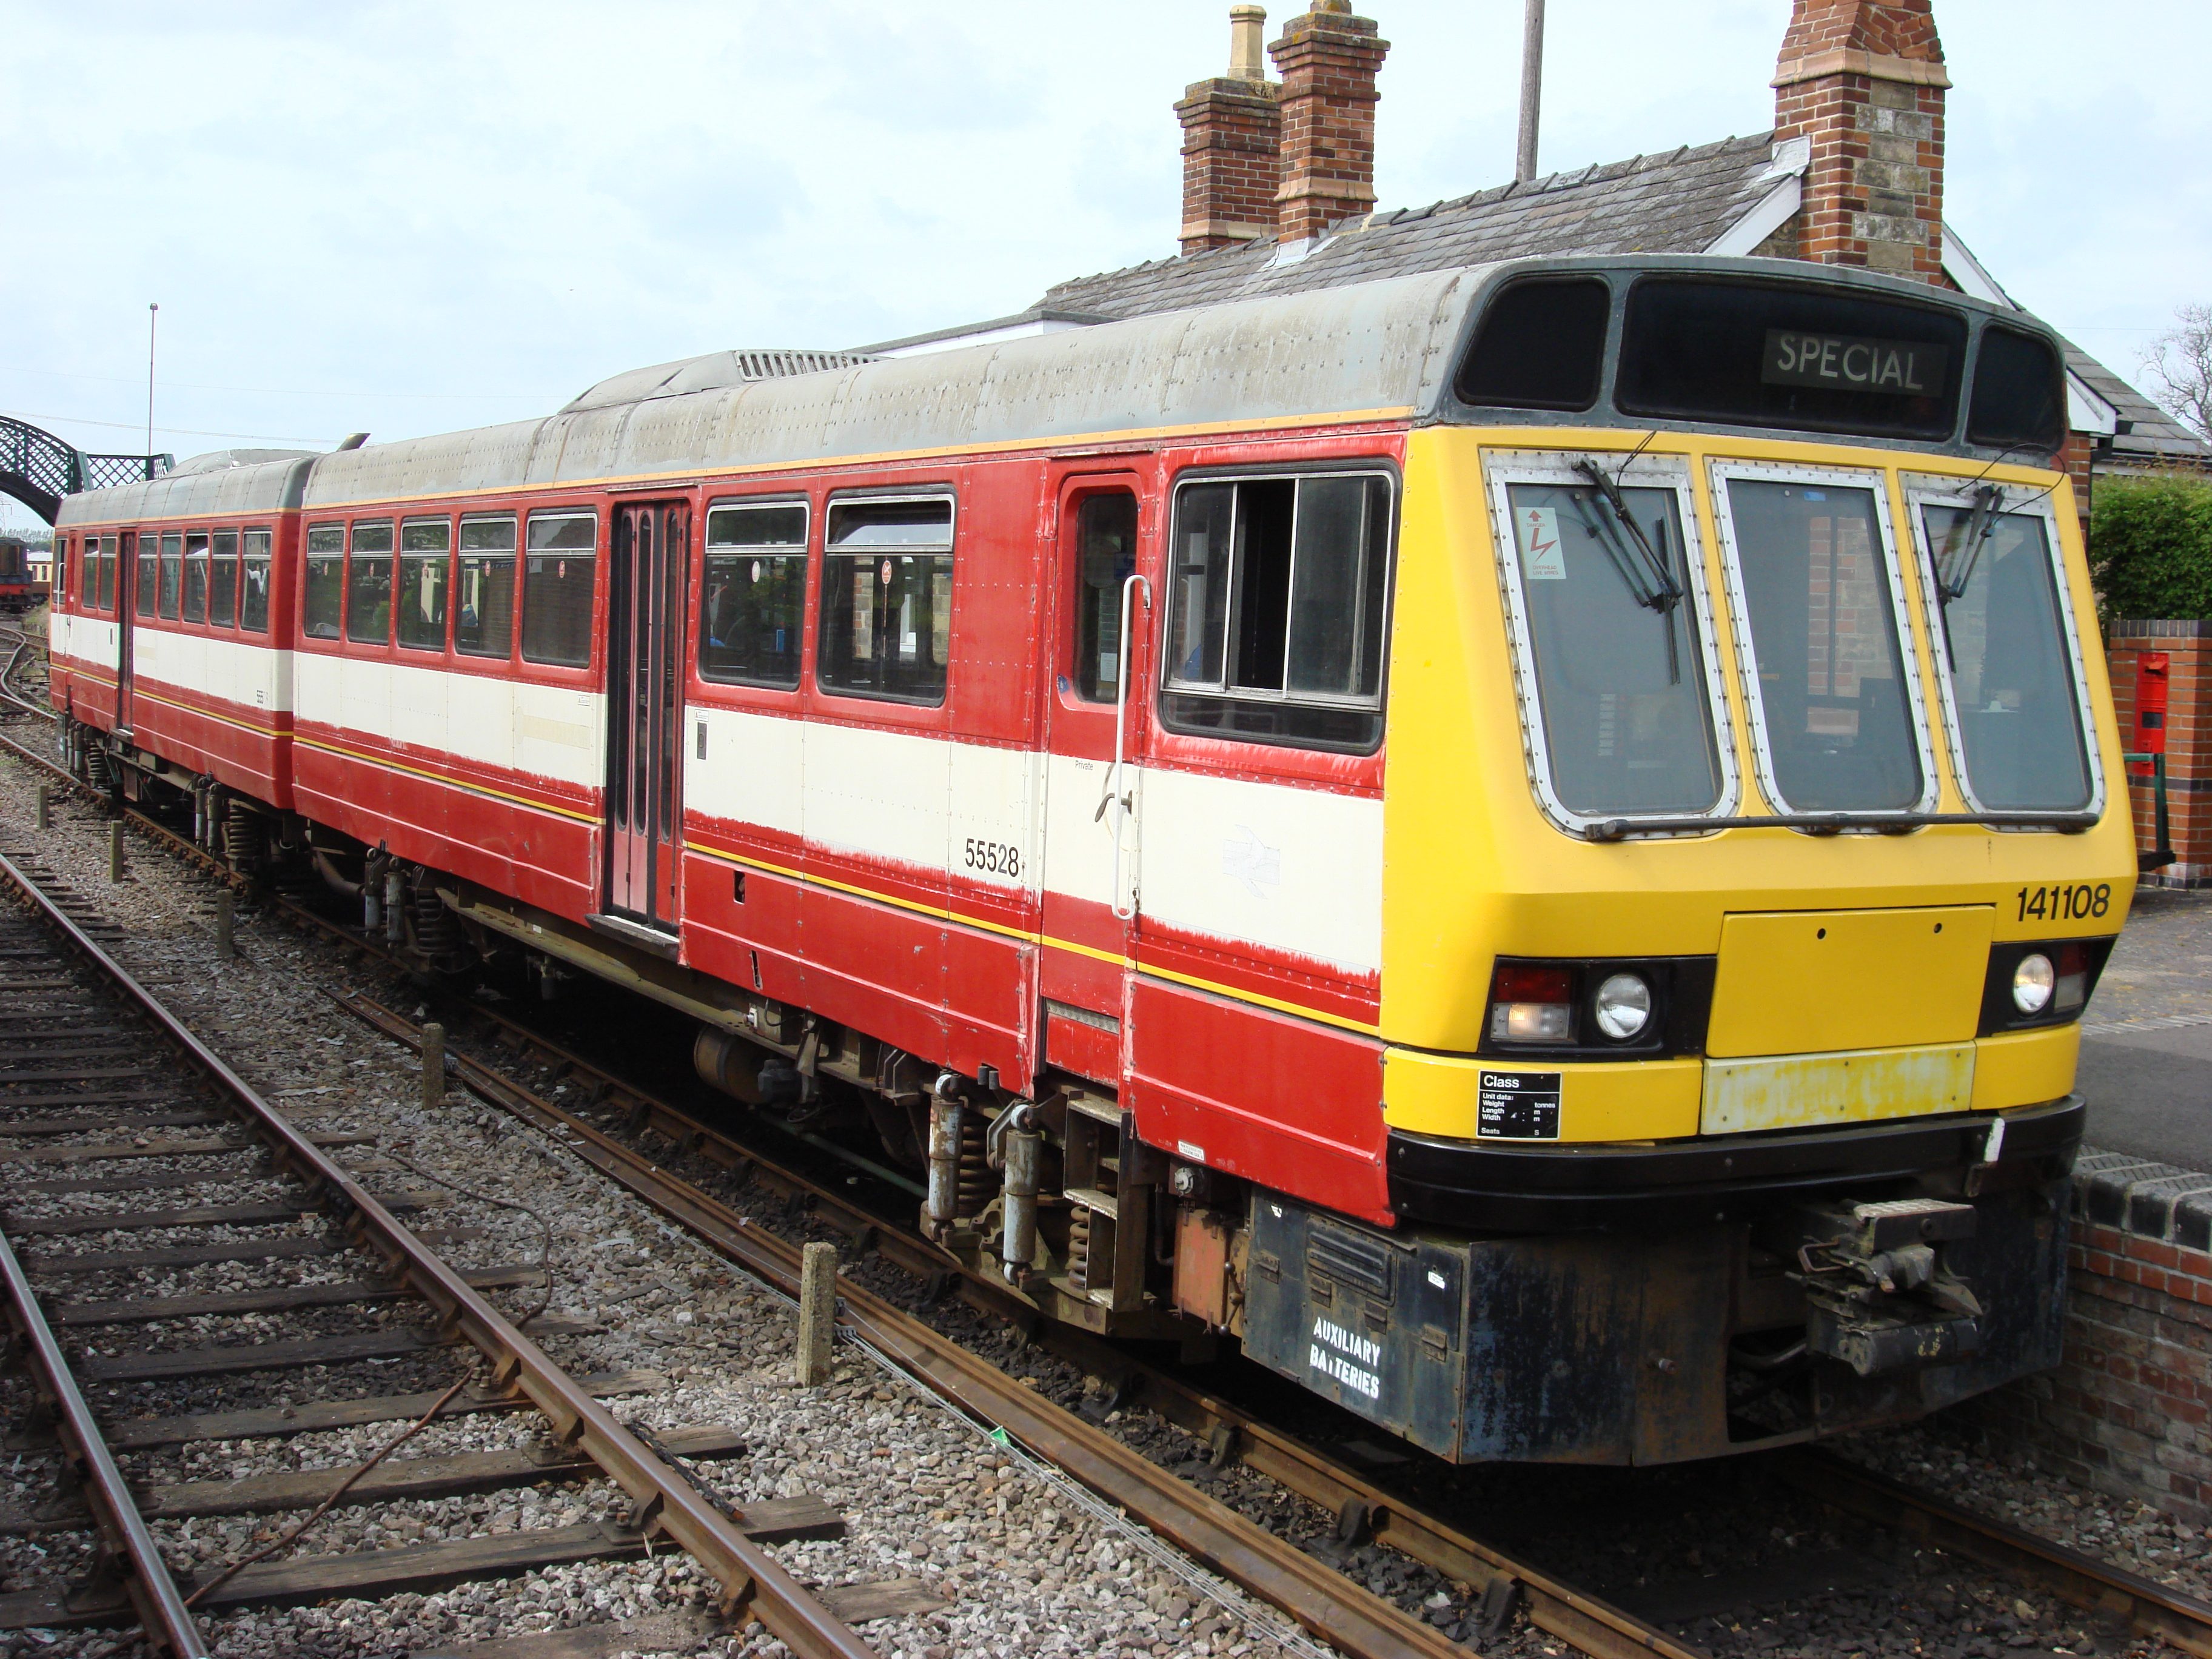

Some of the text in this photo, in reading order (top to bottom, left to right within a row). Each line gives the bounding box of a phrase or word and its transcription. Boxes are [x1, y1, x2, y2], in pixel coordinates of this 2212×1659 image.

[1777, 334, 1923, 390] SPECIAL
[1075, 760, 1093, 771] Private
[965, 837, 1019, 877] 55528
[2018, 883, 2111, 922] 141108
[1483, 1074, 1520, 1088] Class
[1482, 1099, 1504, 1108] Weight
[1313, 1316, 1381, 1367] AUXILIARY
